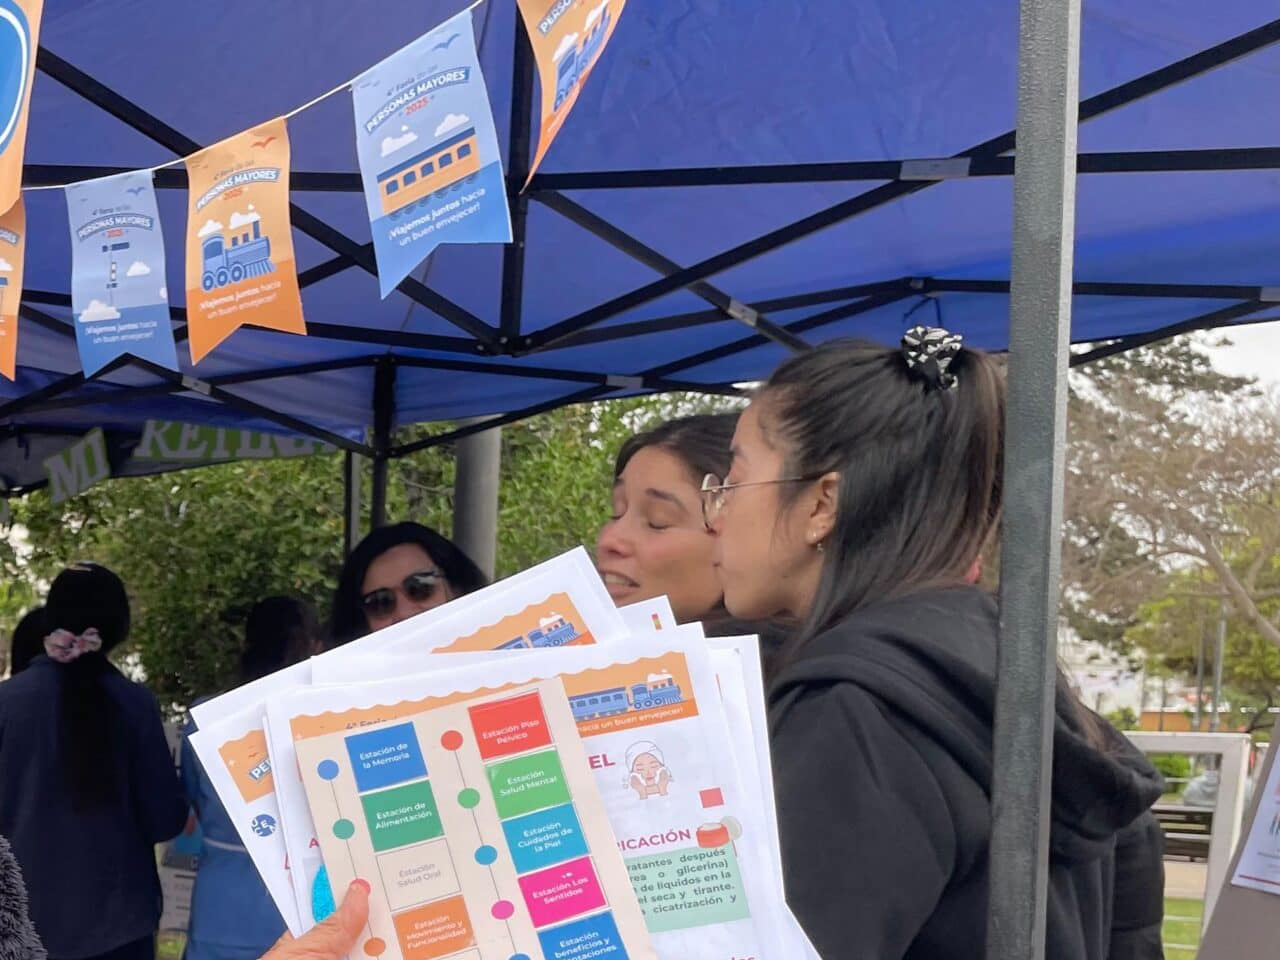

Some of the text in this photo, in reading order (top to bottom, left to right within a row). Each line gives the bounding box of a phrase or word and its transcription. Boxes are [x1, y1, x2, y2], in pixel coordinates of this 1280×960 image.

[366, 88, 417, 132] PERSONAS
[416, 70, 466, 95] MAYORES
[233, 169, 277, 187] MAYORES
[43, 427, 109, 502] MI
[359, 743, 408, 761] Estación de
[372, 752, 410, 767] Memoria
[500, 776, 557, 797] Salud Mental
[506, 770, 545, 785] Estación
[414, 802, 426, 811] de
[560, 827, 573, 836] de
[616, 828, 691, 851] ICACIÓN
[679, 848, 726, 864] después
[676, 859, 729, 877] glicerina)
[640, 882, 654, 893] de
[703, 873, 718, 882] en
[721, 870, 731, 879] la
[650, 893, 676, 903] seca
[679, 891, 686, 899] y
[693, 883, 735, 896] tirante.
[652, 894, 737, 914] cicatrización y
[554, 937, 610, 959] beneficios y
[559, 931, 599, 948] Estación
